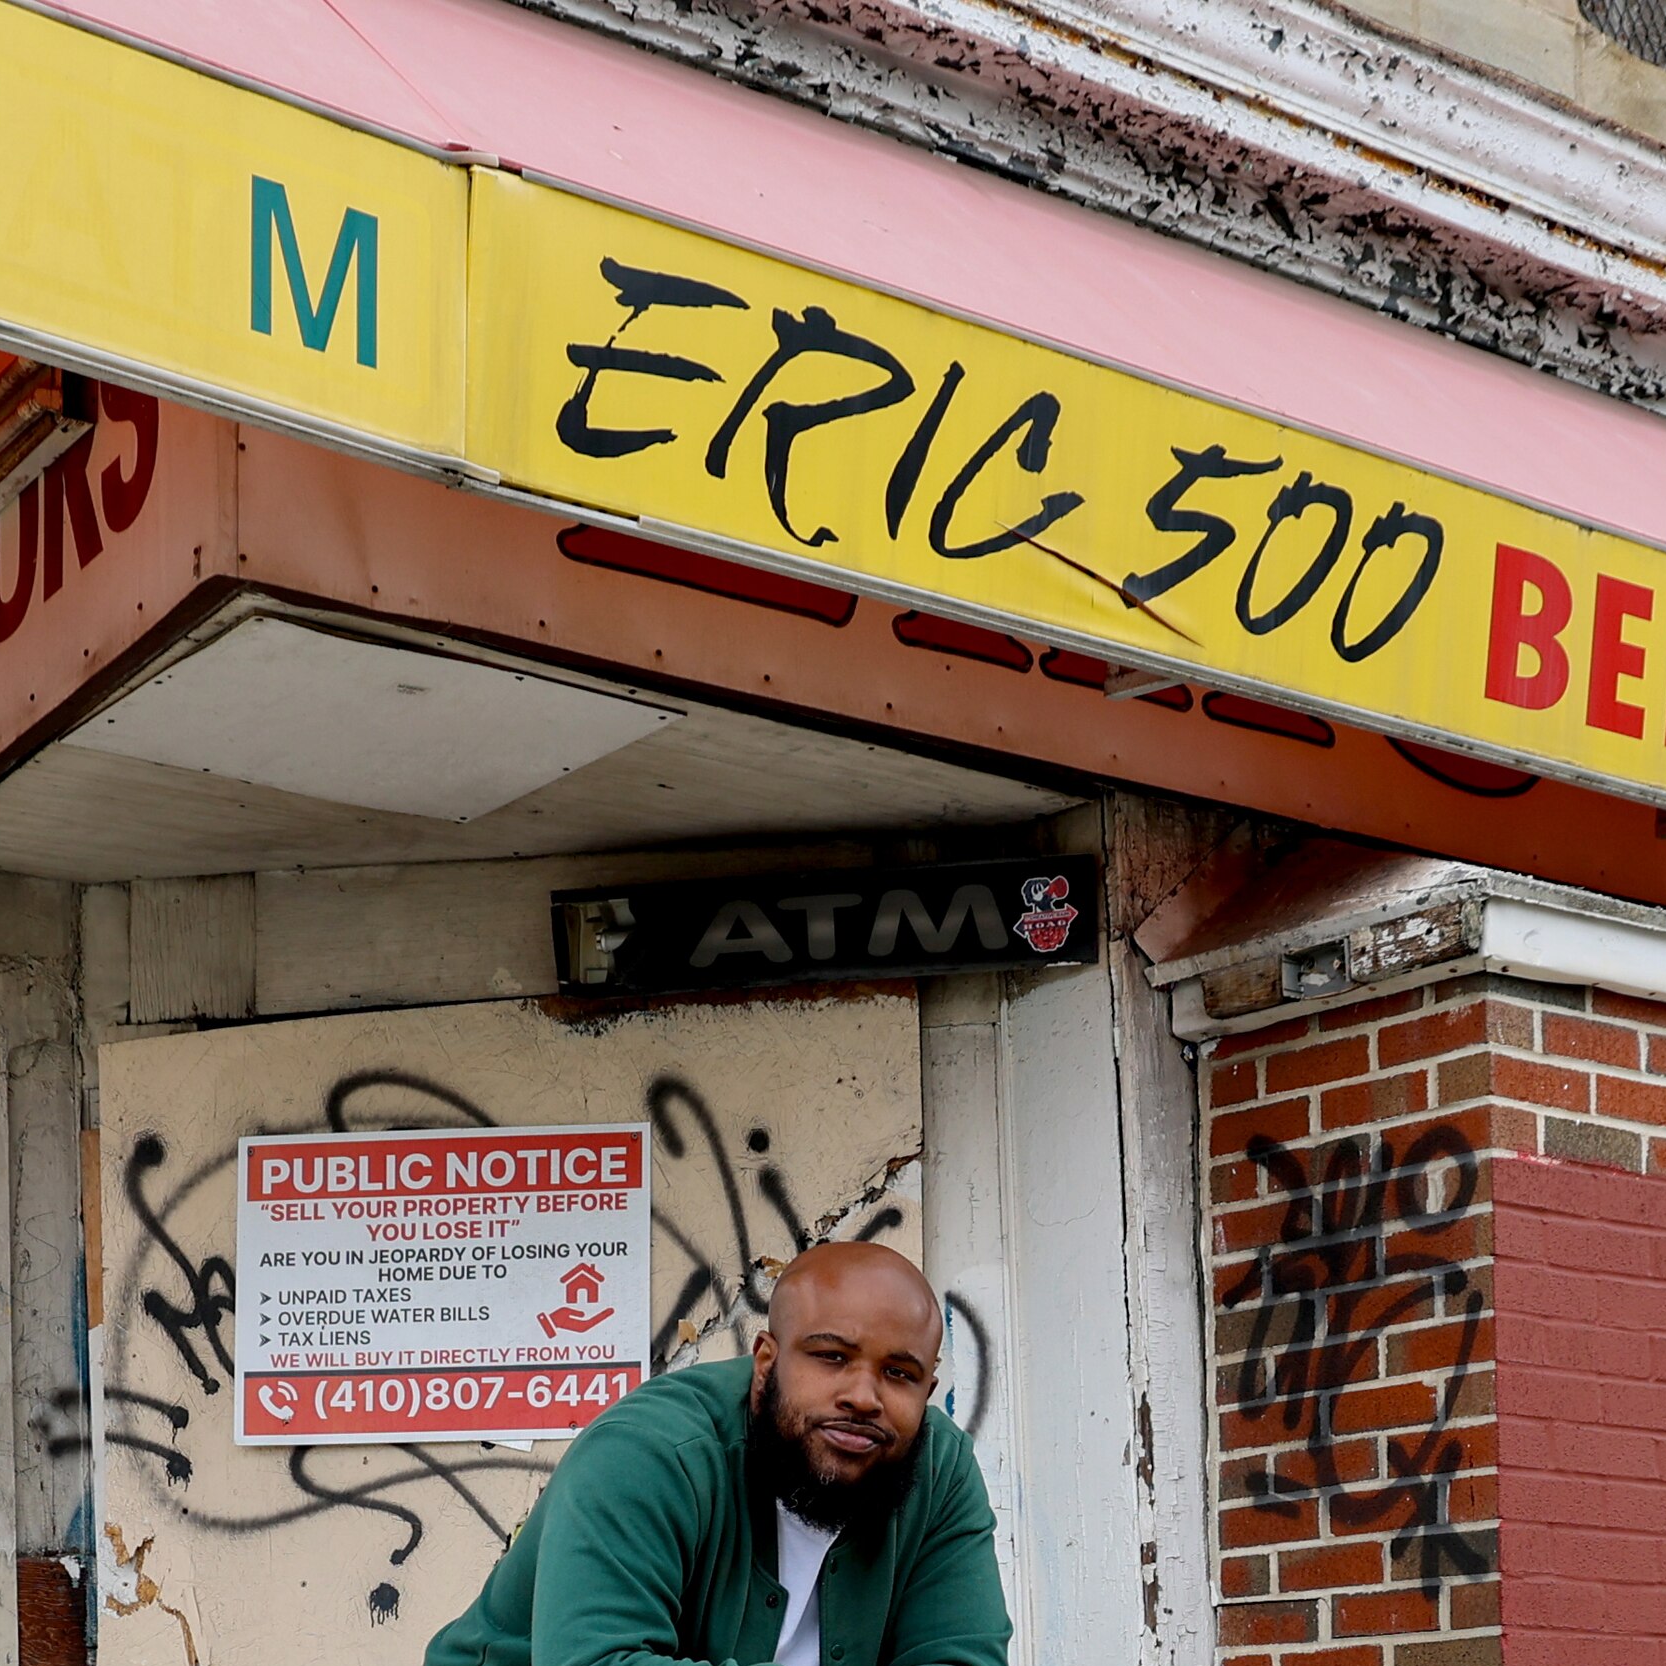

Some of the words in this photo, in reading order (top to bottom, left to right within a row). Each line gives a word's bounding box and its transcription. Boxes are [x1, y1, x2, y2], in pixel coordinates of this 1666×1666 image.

[250, 173, 379, 370] M
[555, 254, 1086, 561] ERIC
[1121, 443, 1445, 664] 500
[688, 884, 1009, 968] ATM
[261, 1153, 433, 1195] PUBLIC
[445, 1146, 628, 1189] NOTICE
[332, 1199, 397, 1220] YOUR
[403, 1195, 530, 1218] PROPERTY
[536, 1192, 628, 1214] BEFORE
[366, 1221, 417, 1243] YOU
[423, 1220, 483, 1241] LOSE
[259, 1252, 296, 1268] ARE
[301, 1250, 341, 1266] YOU
[345, 1249, 365, 1265] IN
[368, 1246, 467, 1264] JEOPARDY
[471, 1245, 497, 1261] OF
[501, 1243, 571, 1261] LOSING
[575, 1241, 629, 1258] YOUR
[378, 1265, 434, 1283] HOME
[438, 1264, 477, 1281] DUE
[481, 1264, 508, 1280] TO
[278, 1289, 348, 1306] UNPAID
[352, 1287, 412, 1304] TAXES
[277, 1310, 366, 1327] OVERDUE
[371, 1307, 435, 1325] WATER
[440, 1305, 491, 1322] BILLS
[278, 1331, 315, 1347] TAX
[318, 1330, 372, 1346] LIENS
[269, 1352, 300, 1369] WE
[304, 1350, 350, 1368] WILL
[355, 1350, 394, 1367] BUY
[398, 1349, 416, 1366] IT
[420, 1347, 511, 1365] DIRECTLY
[515, 1346, 571, 1363] FROM
[575, 1344, 616, 1361] YOU
[313, 1371, 632, 1421] (410)807-6441
